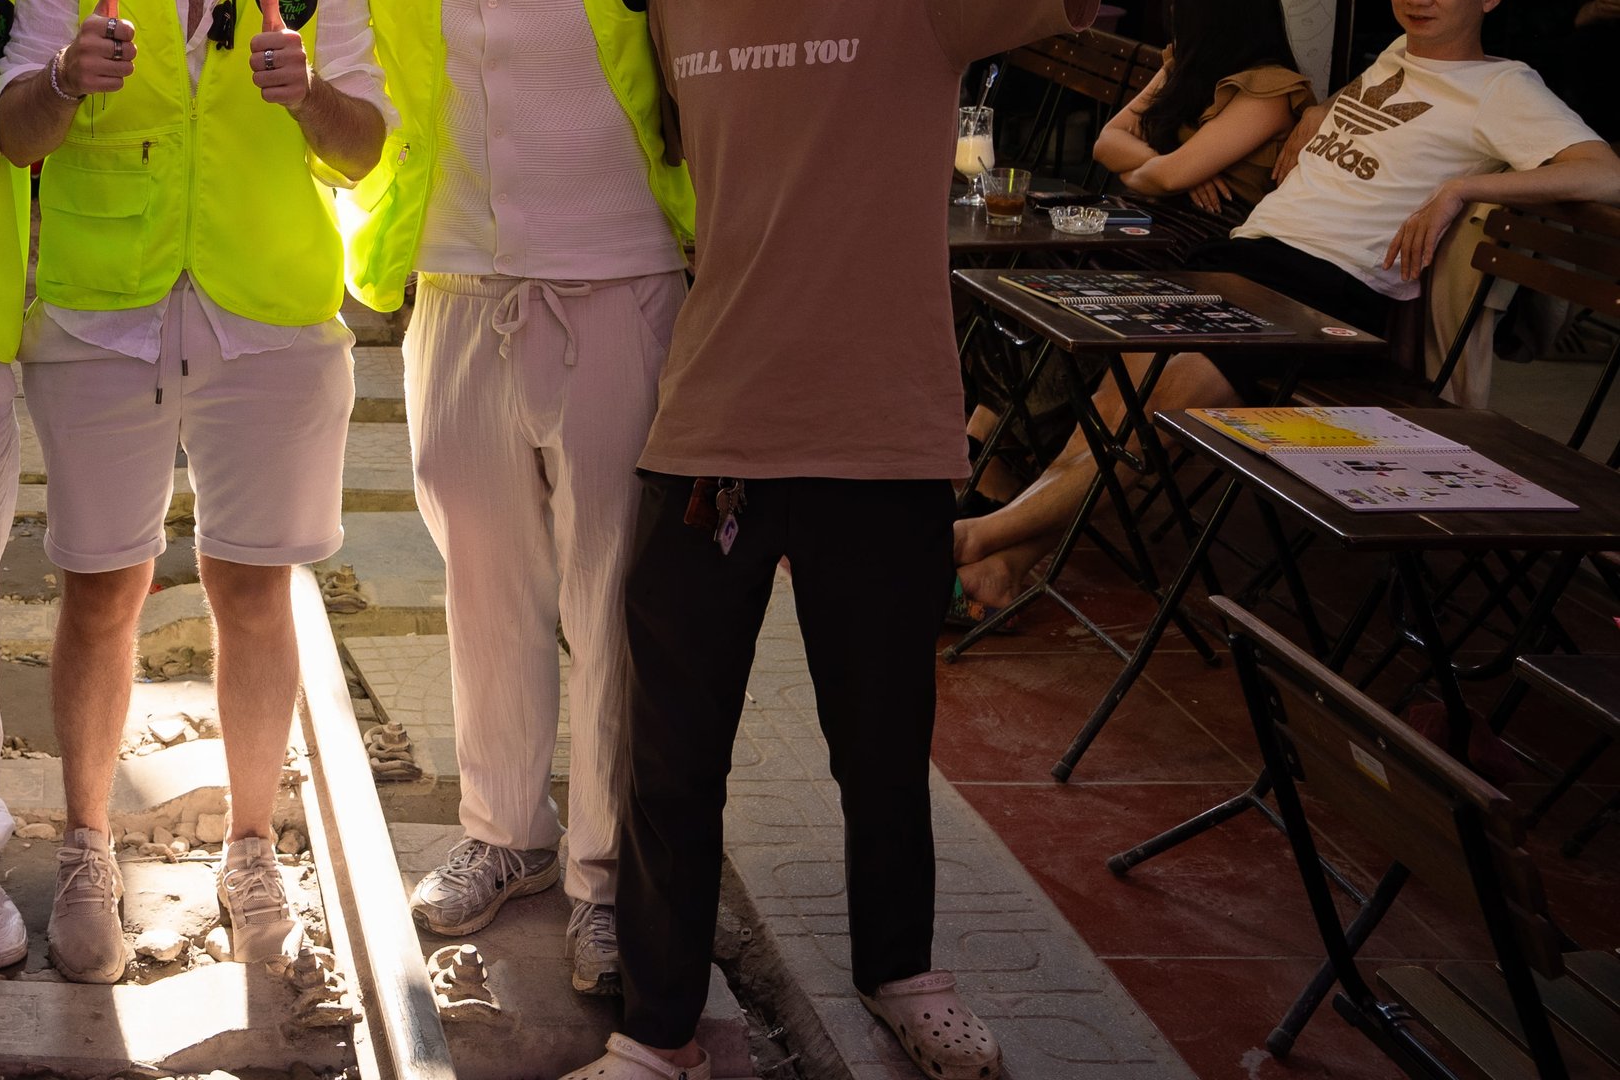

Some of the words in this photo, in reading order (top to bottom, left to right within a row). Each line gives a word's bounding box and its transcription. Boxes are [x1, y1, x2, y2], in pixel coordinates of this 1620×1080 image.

[673, 49, 723, 81] STILL
[728, 42, 797, 71] WITH
[803, 38, 860, 65] YOU
